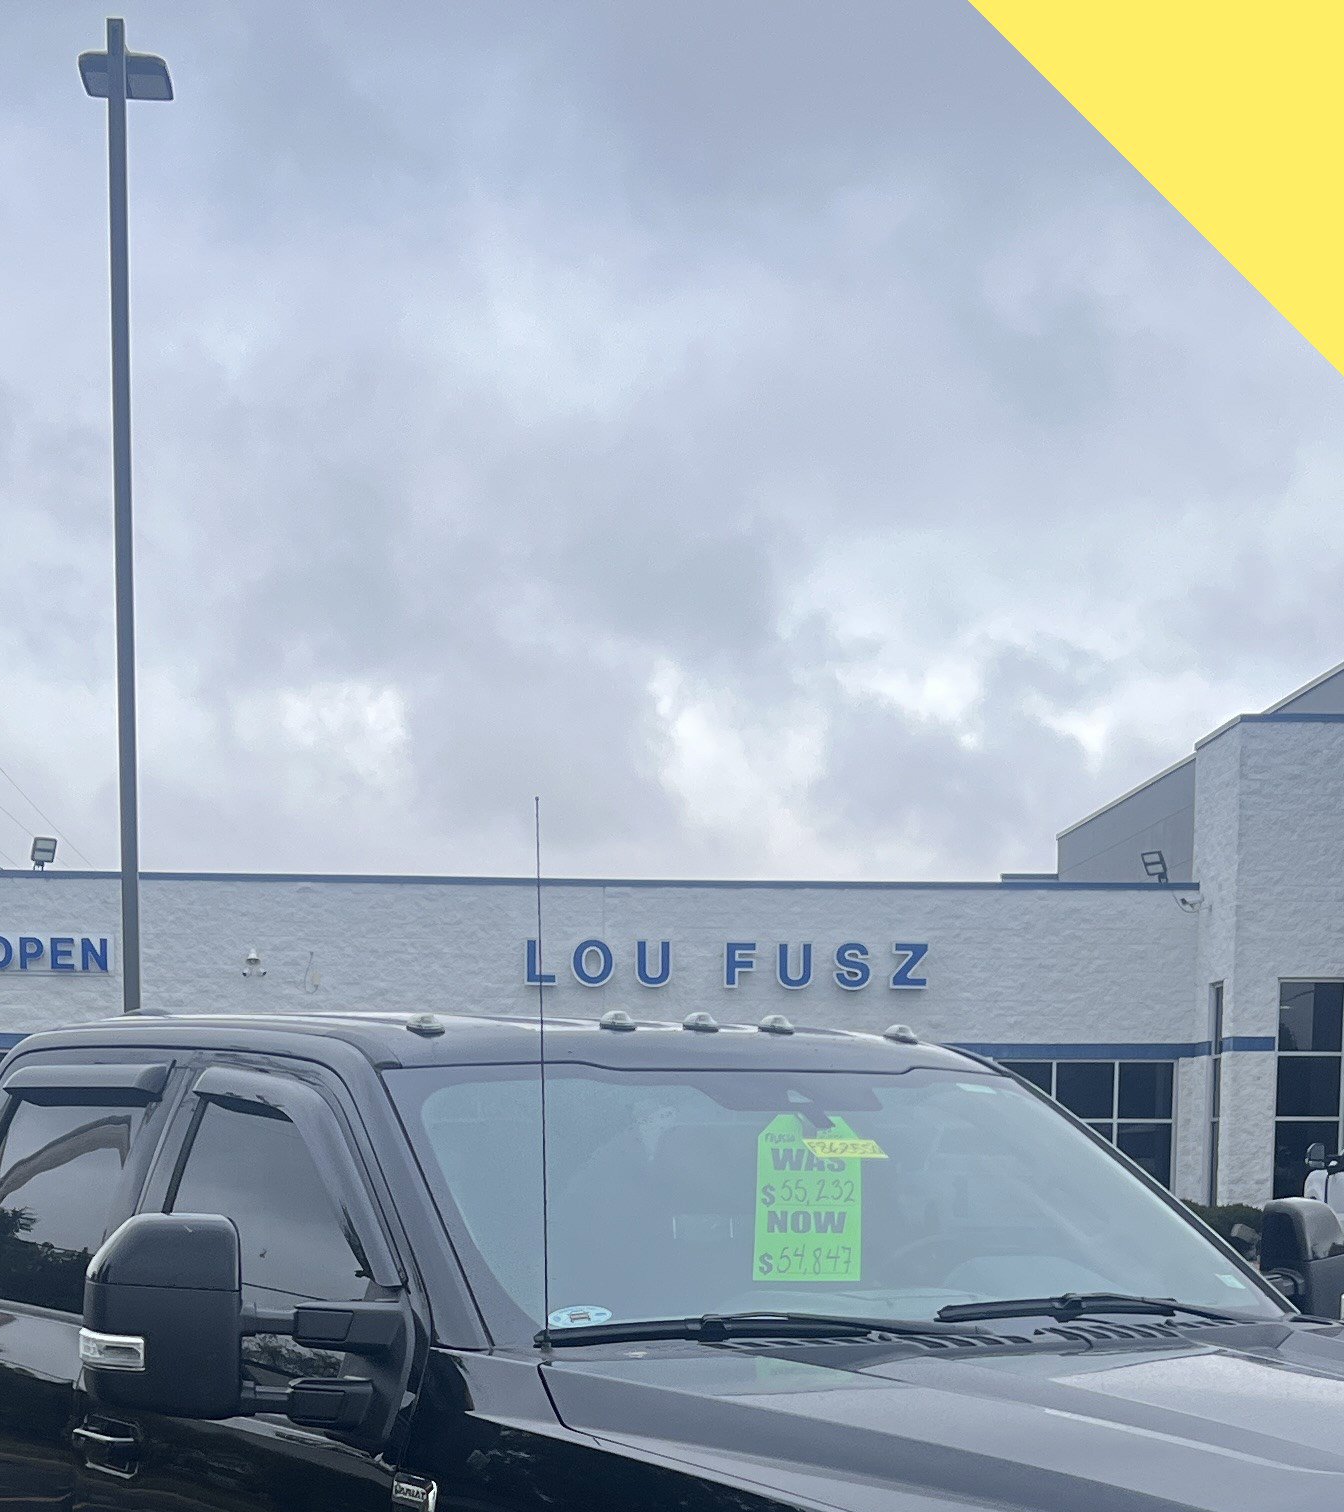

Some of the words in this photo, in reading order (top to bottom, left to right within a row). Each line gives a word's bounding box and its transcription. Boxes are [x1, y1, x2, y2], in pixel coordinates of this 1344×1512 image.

[524, 938, 673, 989] LOU
[723, 941, 931, 991] FUSZ
[770, 1147, 846, 1172] WAS
[767, 1210, 847, 1234] NOW
